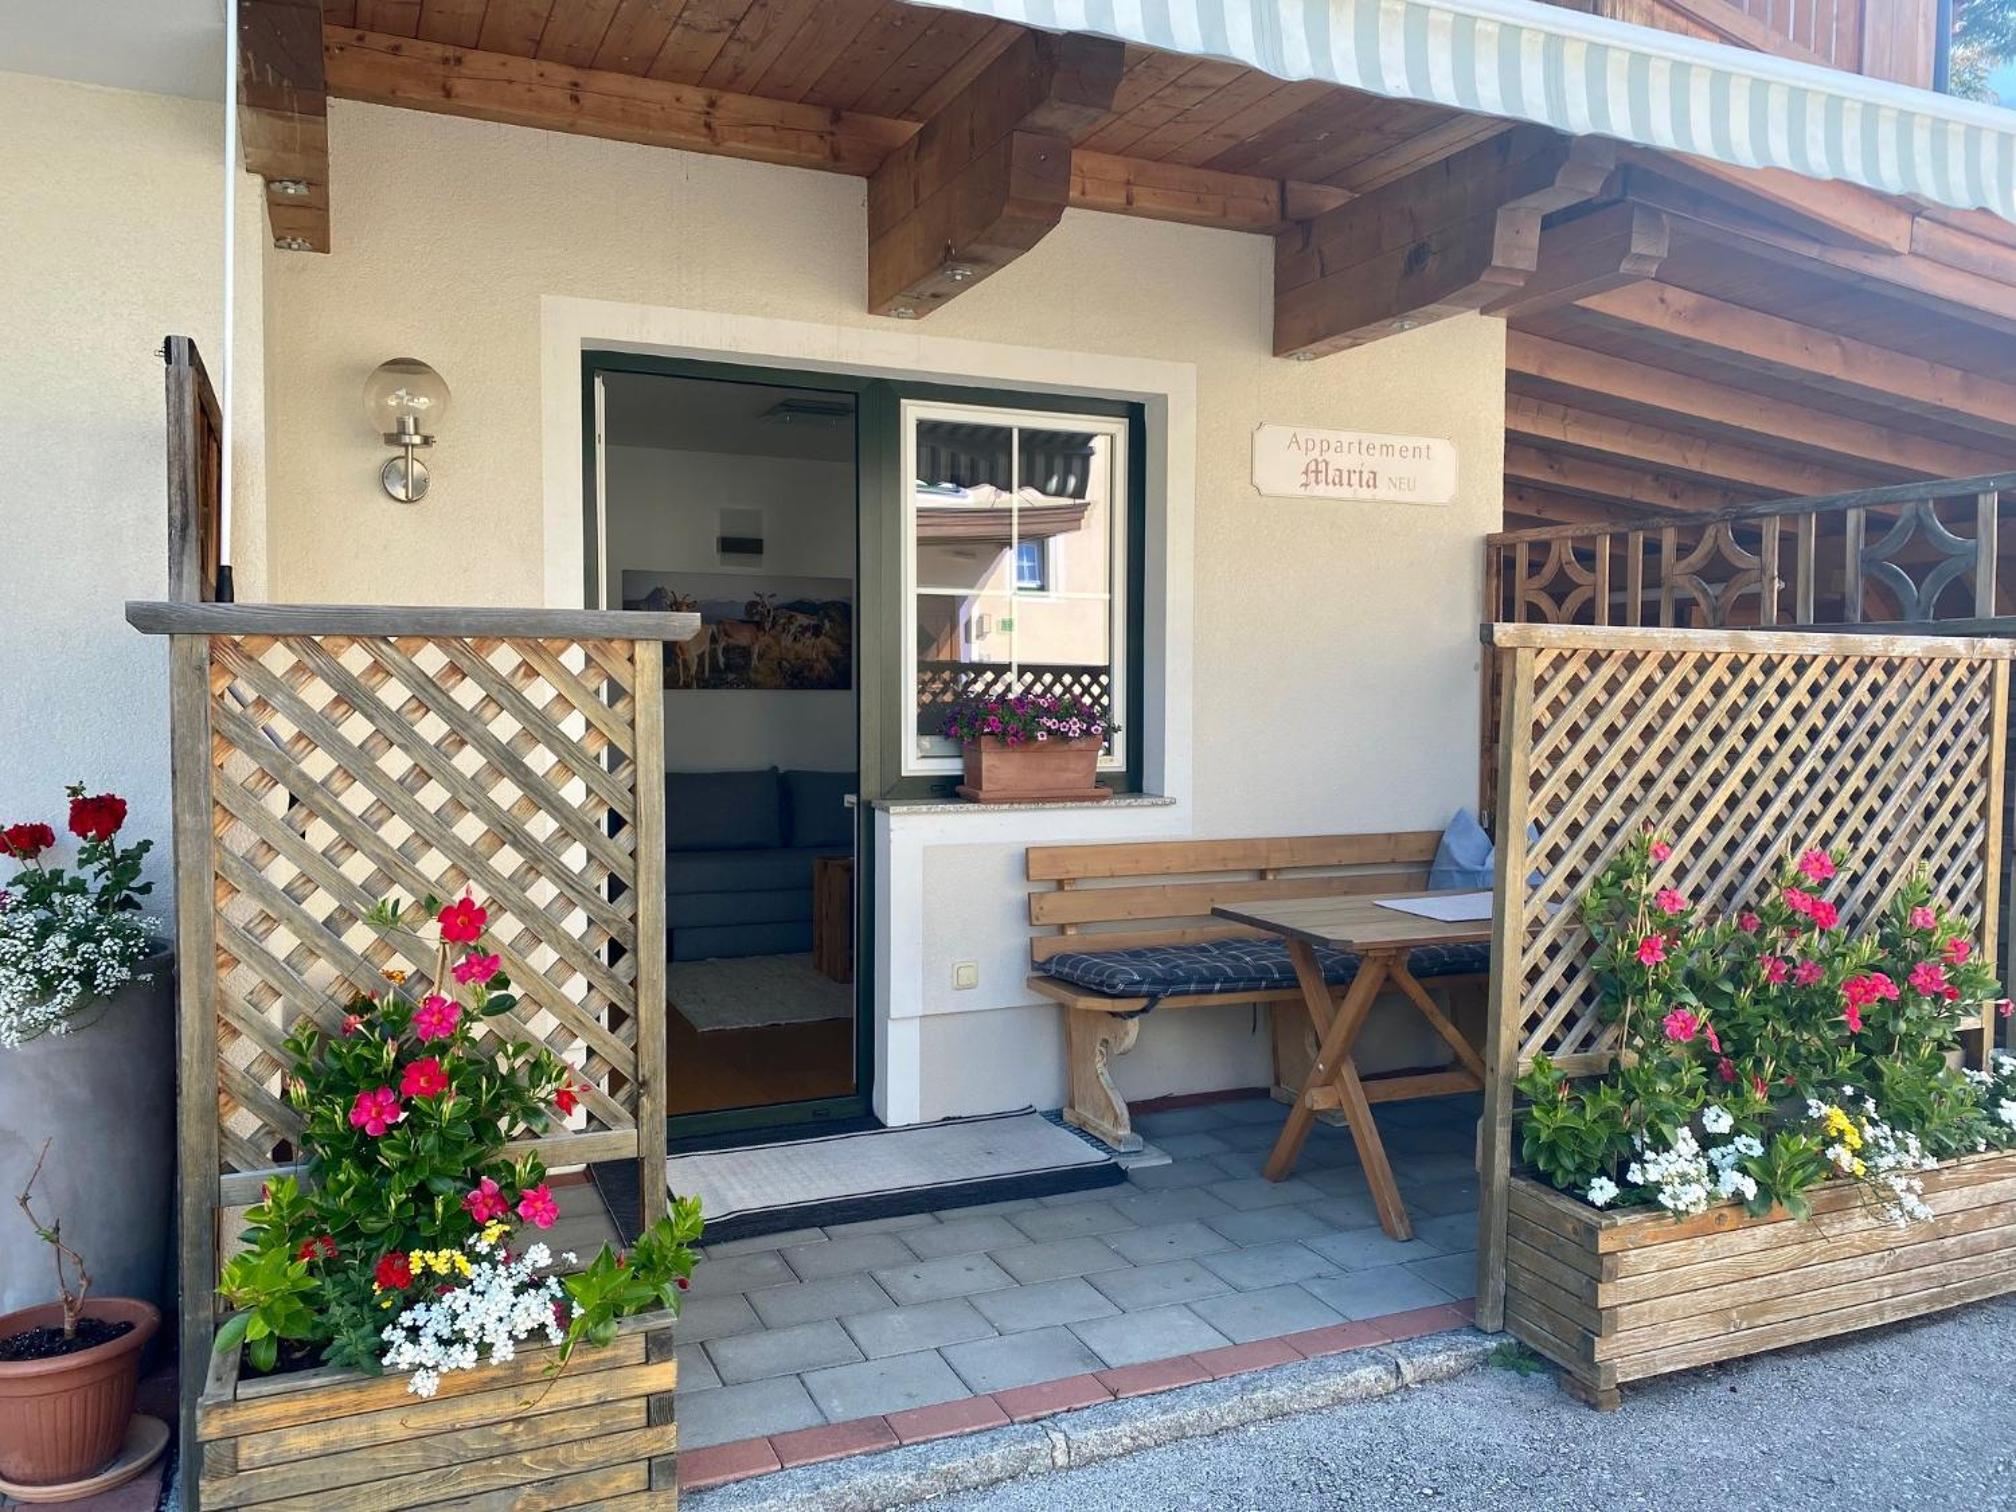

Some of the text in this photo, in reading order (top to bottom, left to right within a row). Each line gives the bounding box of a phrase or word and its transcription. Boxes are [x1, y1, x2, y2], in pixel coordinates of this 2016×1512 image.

[1287, 432, 1432, 460] Appartement
[1299, 458, 1416, 491] Maria NEU
